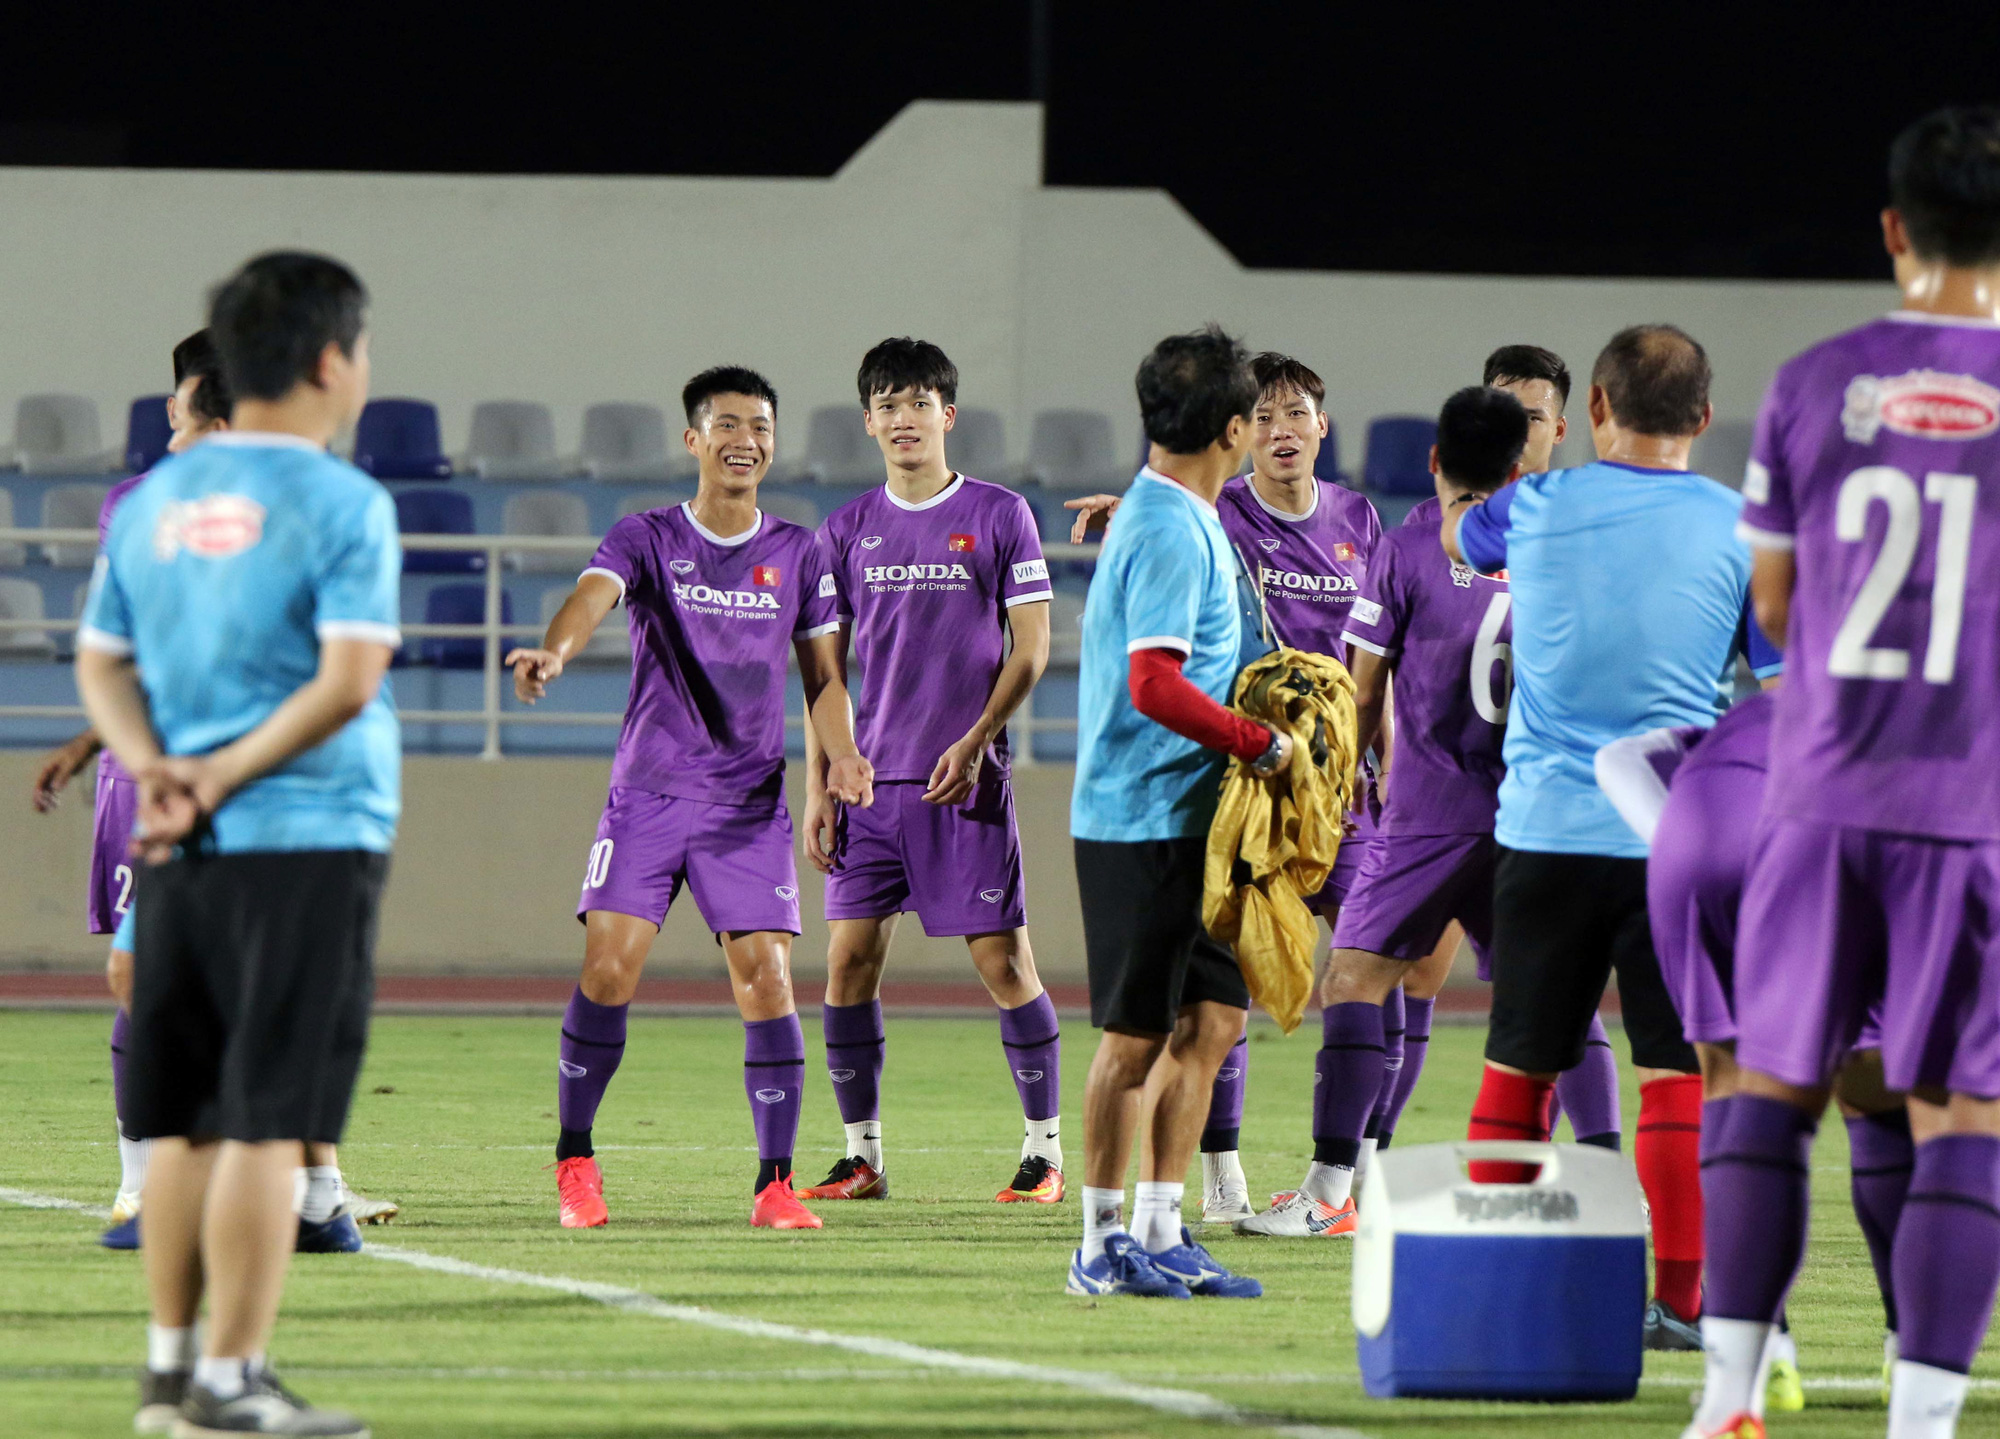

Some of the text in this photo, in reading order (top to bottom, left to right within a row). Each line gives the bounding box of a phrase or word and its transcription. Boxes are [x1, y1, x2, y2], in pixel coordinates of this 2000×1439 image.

[864, 564, 971, 583] HONDA
[1262, 567, 1358, 591] HONDA
[1827, 466, 1978, 684] 21
[672, 580, 781, 609] HONDA
[869, 582, 967, 593] The Power of Dreams
[1264, 587, 1356, 603] The Power of Dreams
[676, 597, 777, 620] The Power of Dreams
[1470, 592, 1513, 725] 6
